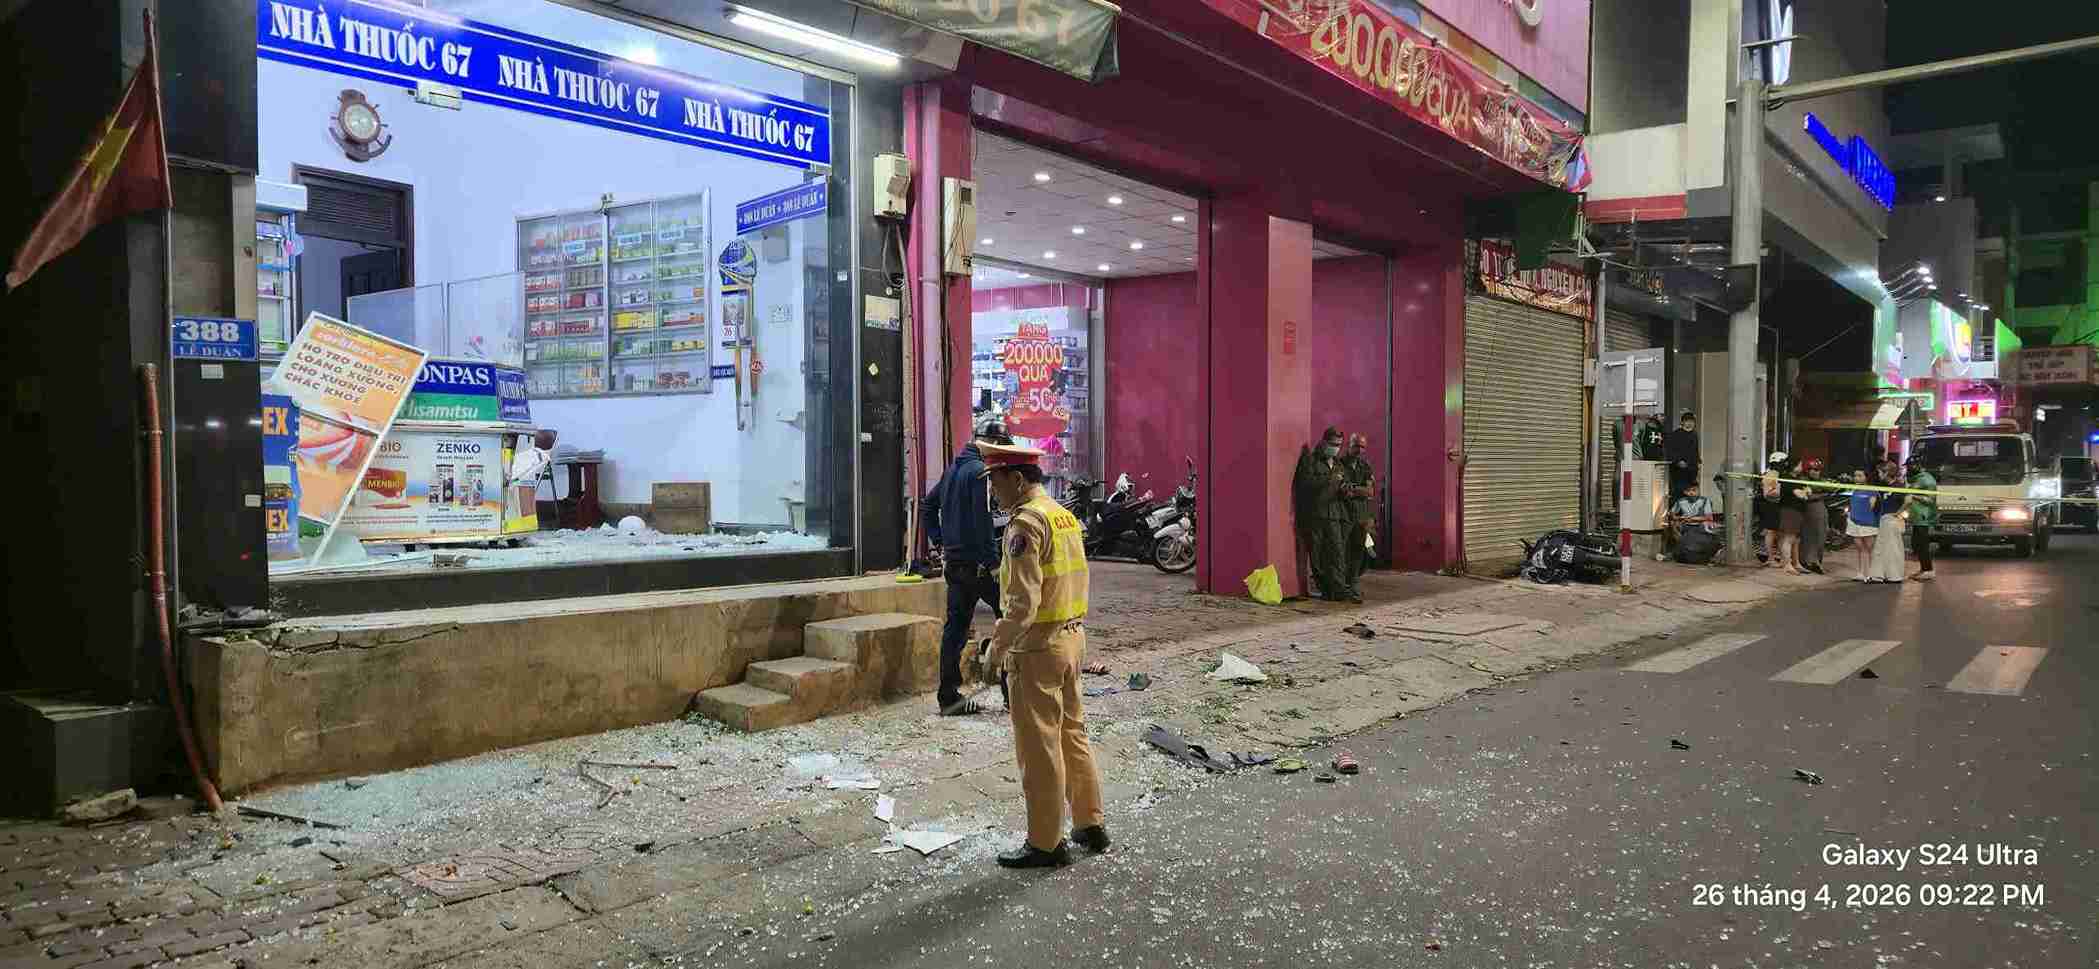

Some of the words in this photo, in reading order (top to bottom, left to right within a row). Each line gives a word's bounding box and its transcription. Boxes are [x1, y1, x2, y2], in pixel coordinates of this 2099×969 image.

[269, 1, 333, 51] NHÀ
[339, 14, 436, 72] THUỐC
[441, 40, 472, 79] 67
[498, 53, 550, 97] NHÀ
[554, 70, 631, 114] THUỐC
[635, 86, 660, 119] 67
[683, 96, 725, 133] NHÀ
[728, 107, 794, 148] THUỐC
[794, 124, 815, 153] 67
[180, 321, 240, 343] 388
[290, 361, 318, 377] CHO
[436, 442, 481, 455] ZENKO
